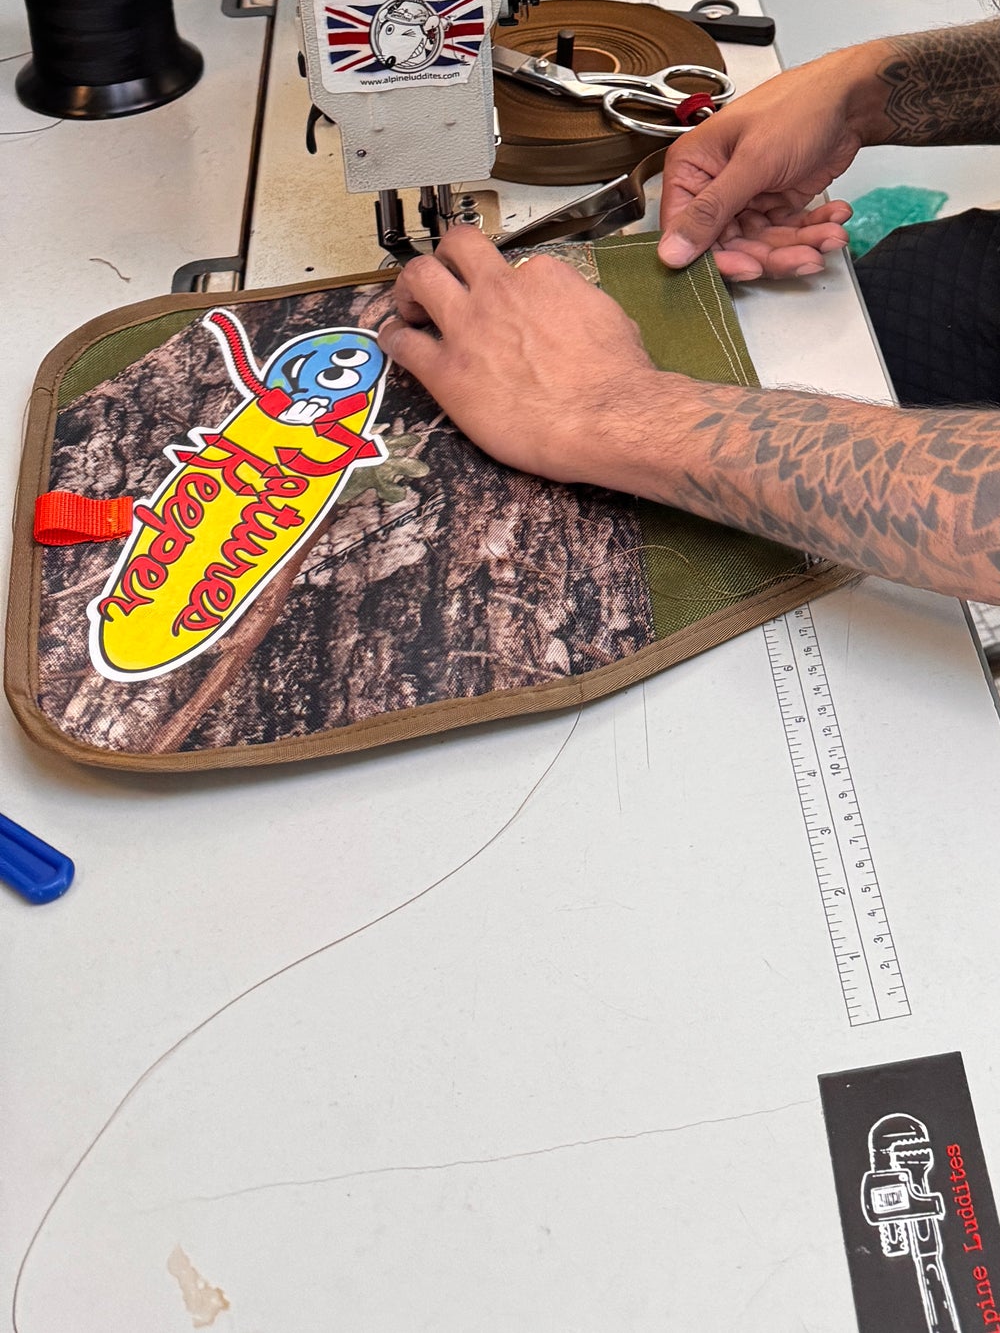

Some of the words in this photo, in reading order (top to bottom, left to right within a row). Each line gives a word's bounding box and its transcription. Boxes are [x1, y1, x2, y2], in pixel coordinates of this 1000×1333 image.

[359, 70, 460, 85] www.alpineluddites.com
[97, 433, 286, 622] Keeper
[172, 420, 381, 637] Natures
[803, 646, 812, 656] 16
[808, 666, 817, 676] 15
[813, 686, 822, 696] 14
[817, 706, 827, 716] 13
[822, 726, 832, 737] 12
[828, 747, 837, 758] 11
[829, 763, 842, 776] 10
[820, 828, 832, 836] 3
[834, 888, 846, 897] 2
[873, 936, 884, 944] 3
[947, 1144, 983, 1252] Luddites
